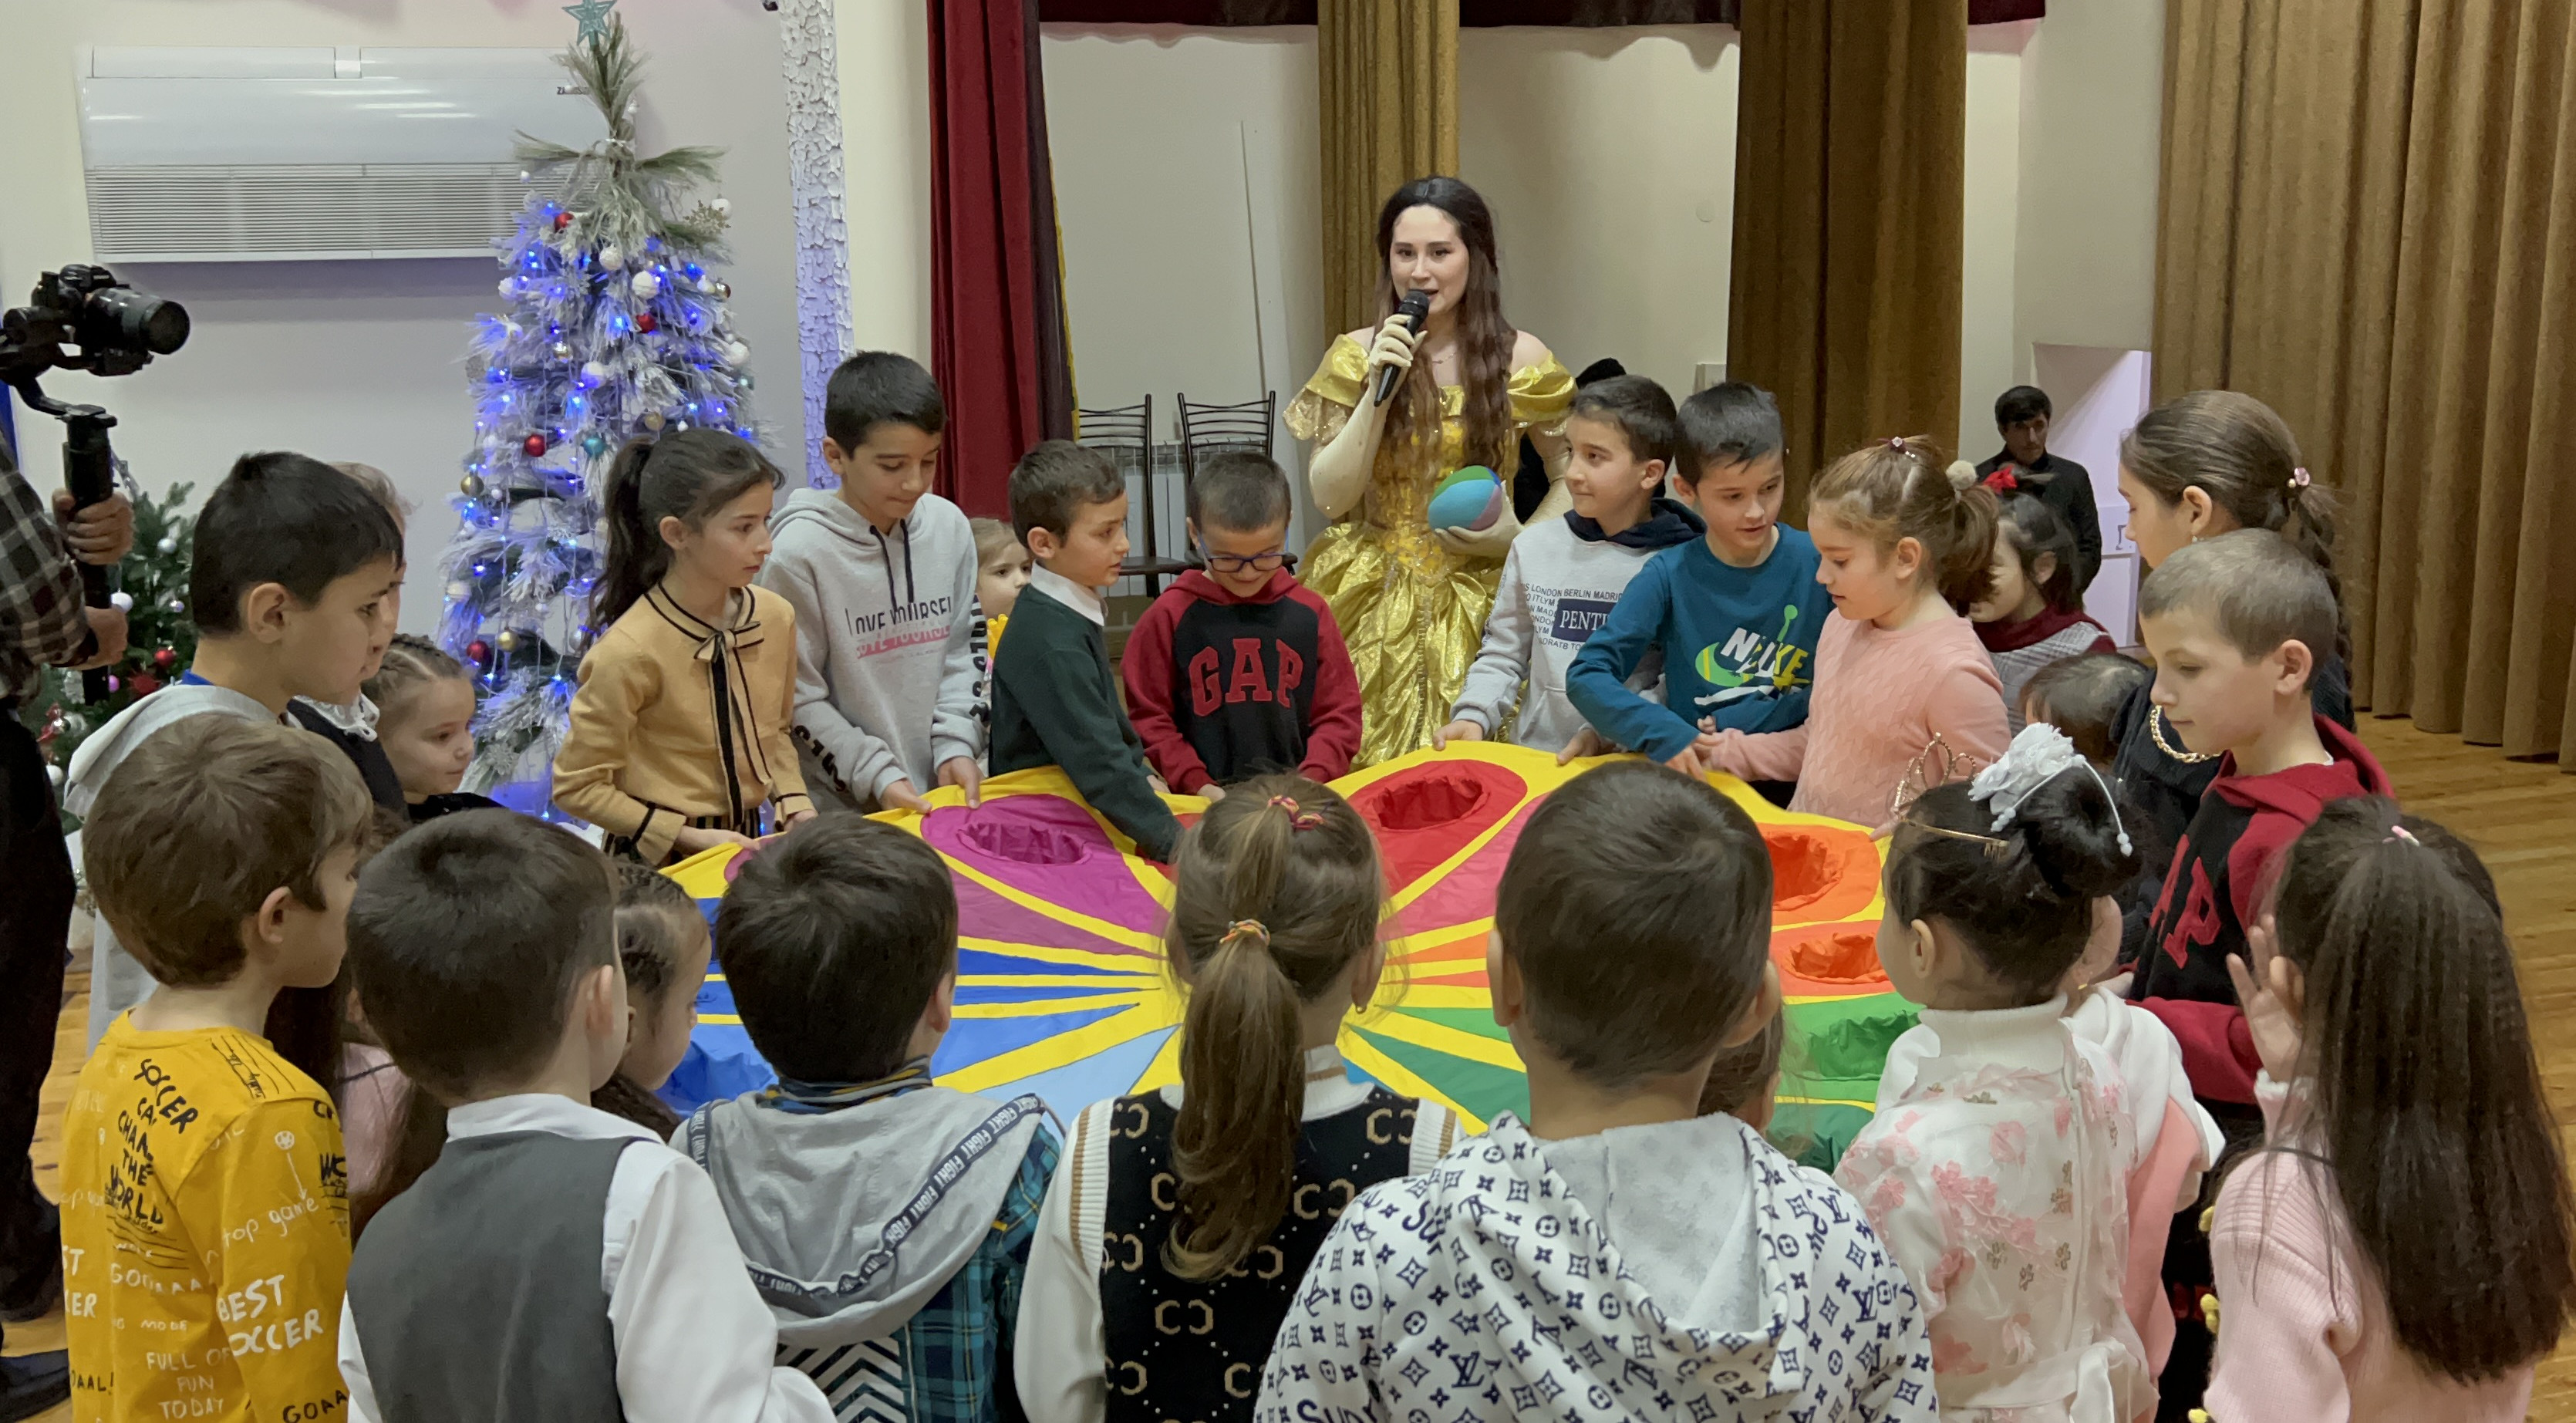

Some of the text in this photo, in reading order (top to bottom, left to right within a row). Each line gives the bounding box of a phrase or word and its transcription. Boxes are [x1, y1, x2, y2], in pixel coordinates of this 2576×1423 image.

[1531, 585, 1563, 597] LONDON
[1563, 588, 1592, 599] BERLIN
[1189, 638, 1303, 717] GAP
[134, 1058, 198, 1134] SOCCER
[987, 1107, 1019, 1135] FIGHT
[959, 1128, 993, 1161] FIGHT
[123, 1147, 155, 1187] THE
[933, 1155, 966, 1190] FIGHT
[268, 1195, 319, 1237] game
[885, 1215, 912, 1247] FIGH
[216, 1274, 285, 1322] BEST
[147, 1352, 196, 1371] FULL
[177, 1375, 214, 1392] FUN
[158, 1398, 224, 1421] TODAY
